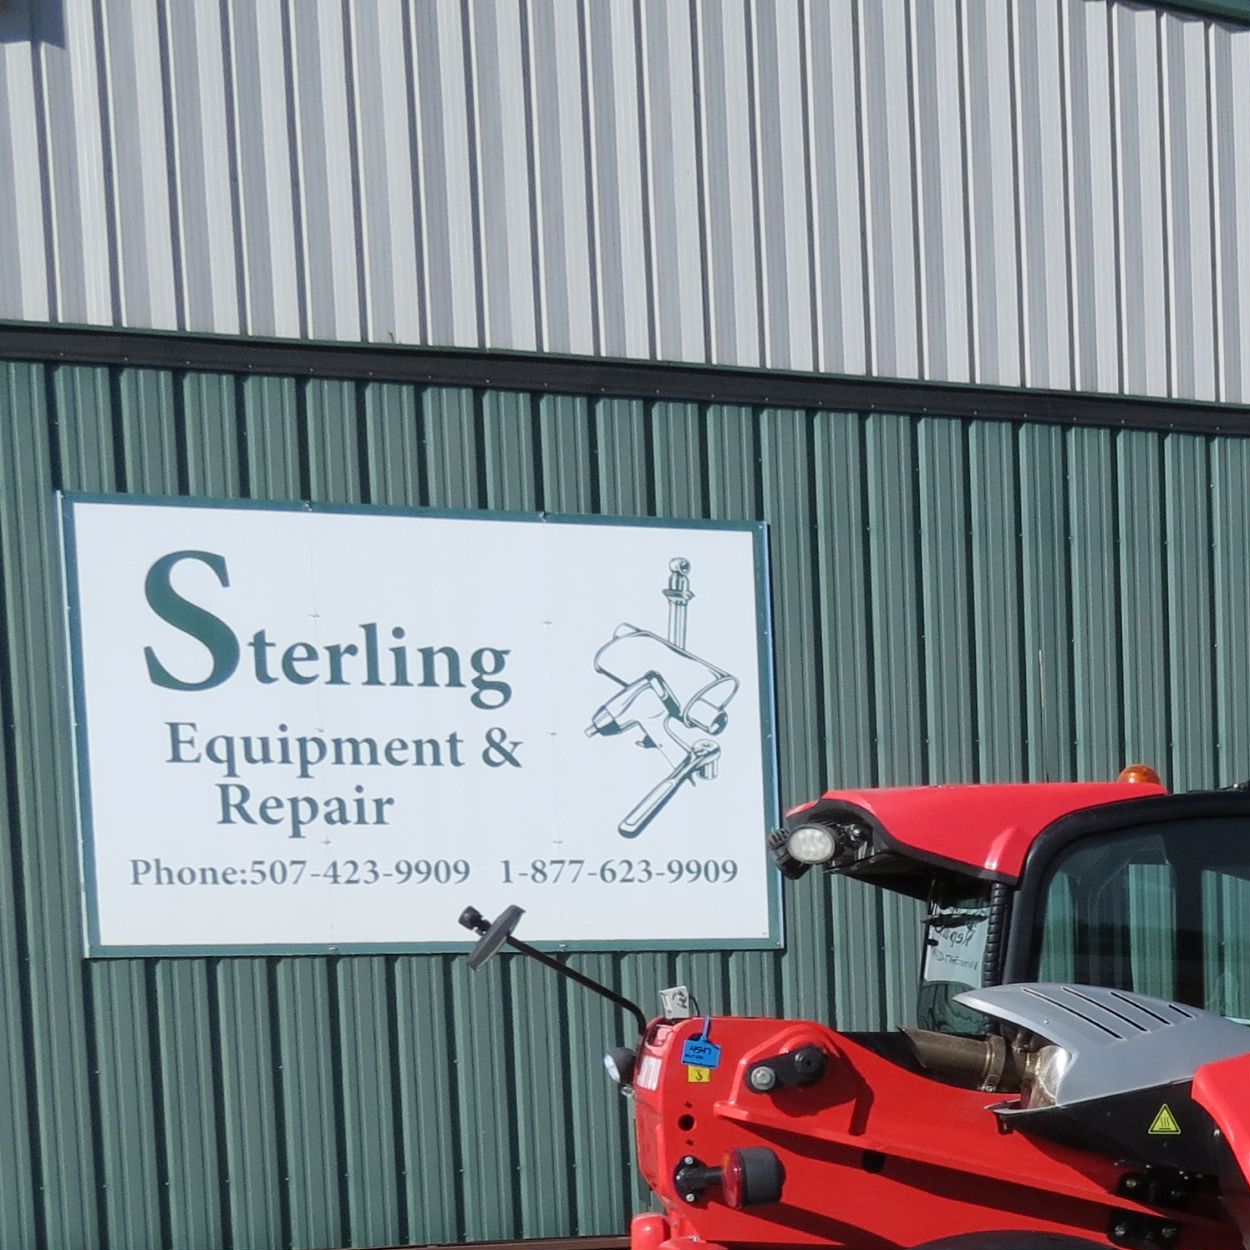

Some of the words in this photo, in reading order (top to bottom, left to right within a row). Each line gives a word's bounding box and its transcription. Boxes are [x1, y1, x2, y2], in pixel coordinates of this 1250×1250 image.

[143, 549, 512, 710] Sterling
[166, 722, 464, 779] Equipment
[481, 727, 523, 768] &
[216, 783, 395, 839] Repair
[129, 858, 471, 886] Phone:507-423-9909
[499, 858, 738, 884] 1-877-623-9909
